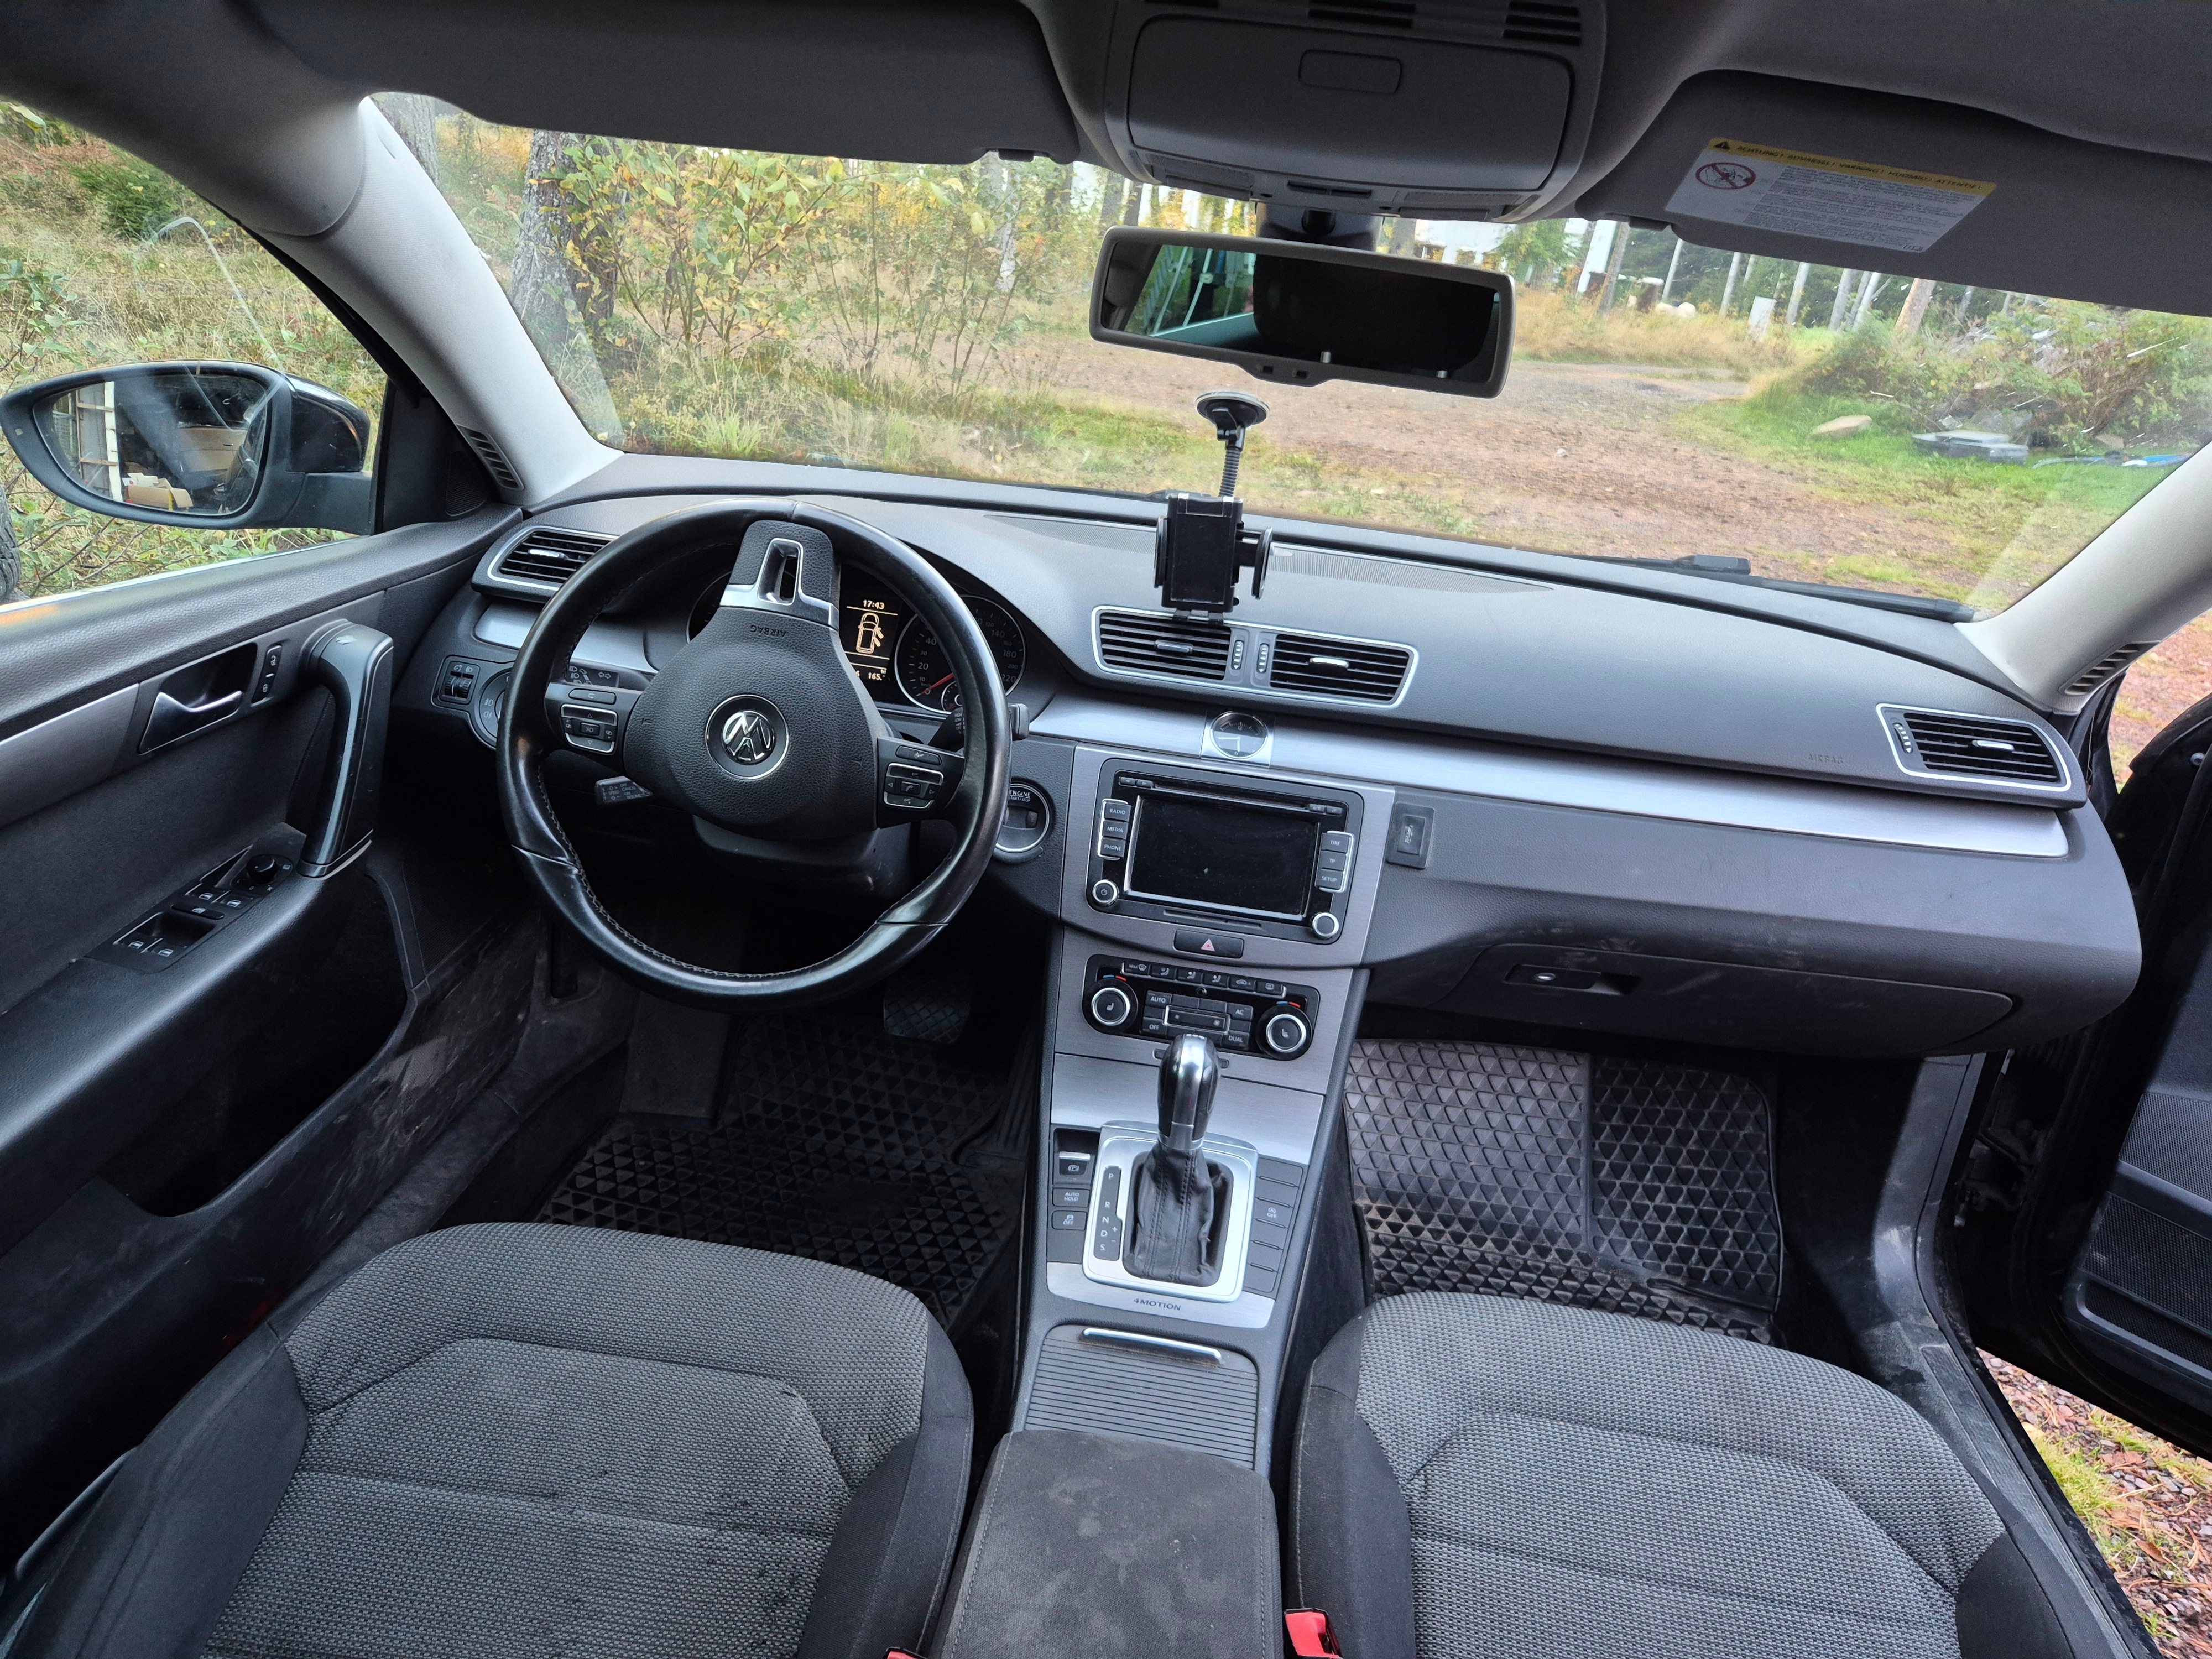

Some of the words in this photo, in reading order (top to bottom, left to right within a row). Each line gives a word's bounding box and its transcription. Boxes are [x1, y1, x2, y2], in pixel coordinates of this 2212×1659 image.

[863, 599, 885, 610] 17:43
[750, 625, 787, 637] AIRBAG
[992, 630, 1005, 638] 140
[925, 638, 937, 646] 40
[1003, 650, 1017, 658] 180
[918, 662, 929, 670] 20
[1001, 674, 1016, 683] 220
[1807, 753, 1844, 764] AIRBAG
[1009, 789, 1031, 798] ENGINE
[1228, 1035, 1244, 1043] DUAL
[1134, 1298, 1181, 1311] 4MOTION
